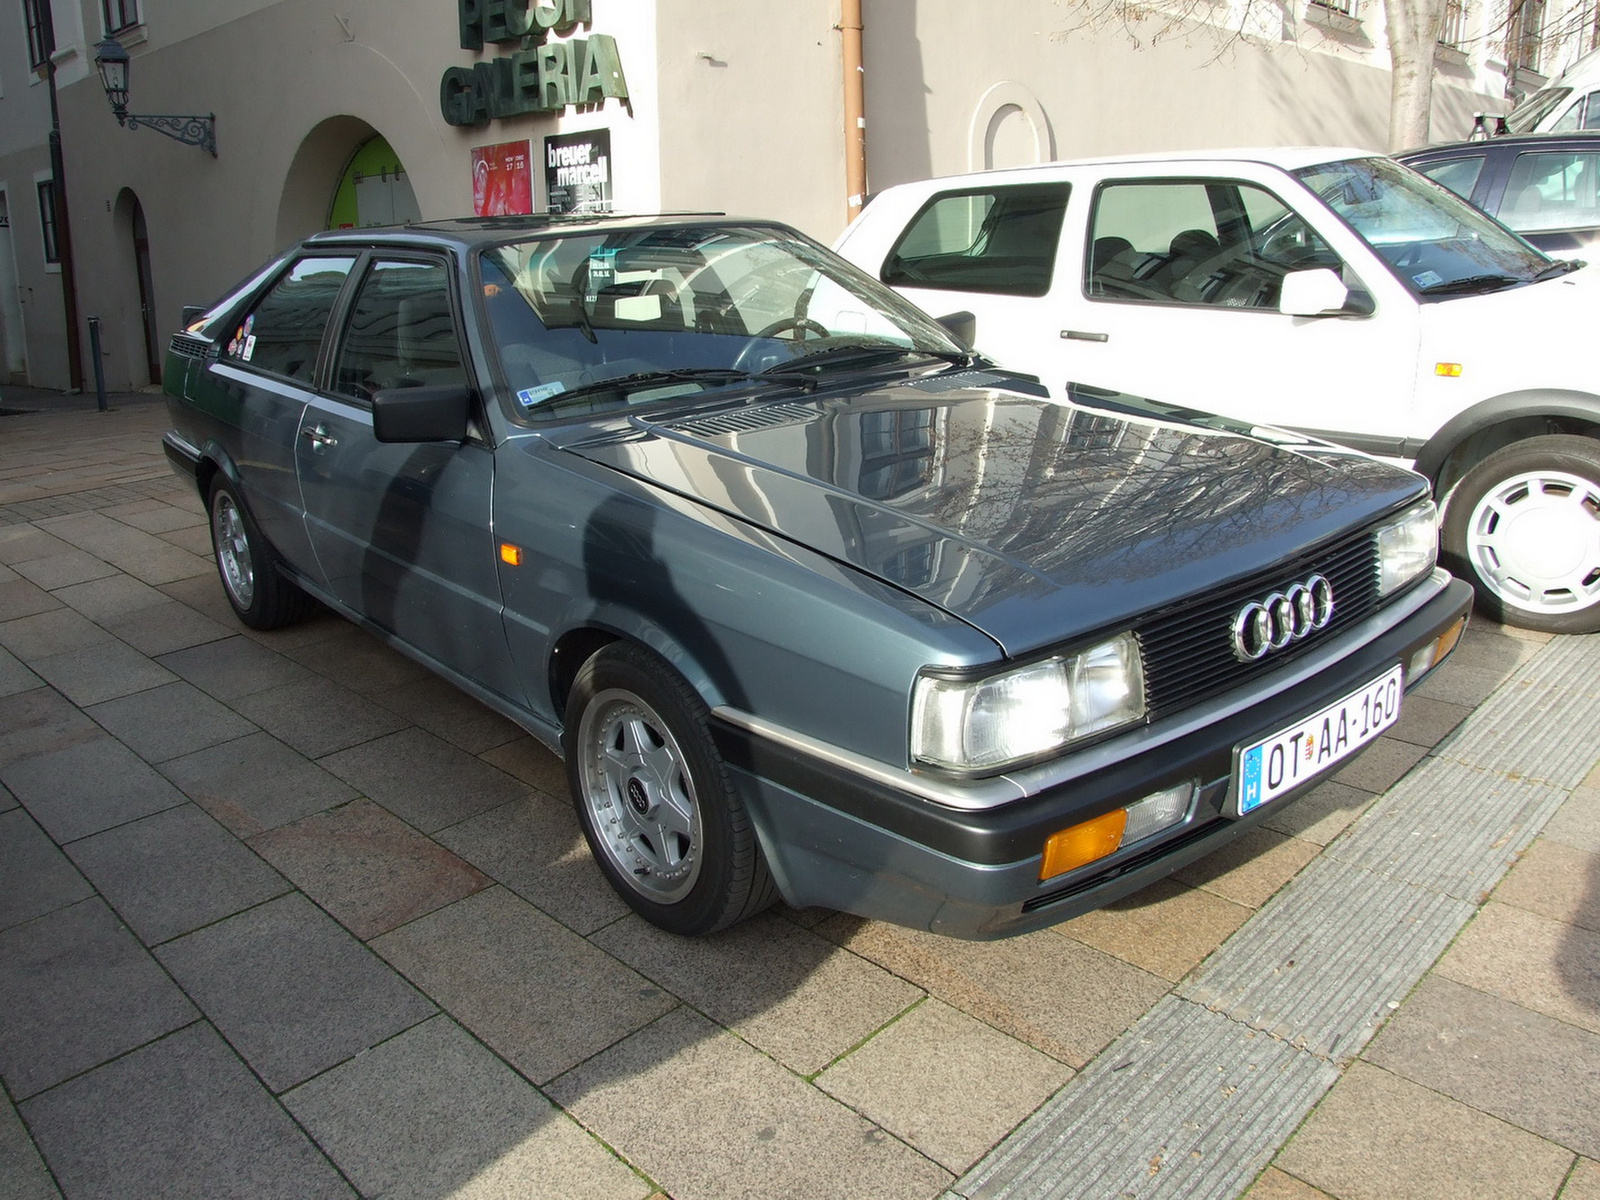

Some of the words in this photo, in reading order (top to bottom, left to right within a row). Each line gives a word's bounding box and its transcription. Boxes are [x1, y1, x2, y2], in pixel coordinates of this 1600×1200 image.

[440, 33, 631, 126] GALÉRIA
[505, 163, 514, 171] 17
[548, 143, 592, 168] breuer
[557, 156, 608, 187] marcell
[1267, 731, 1304, 790] OT
[1317, 678, 1397, 764] AA-160
[1246, 781, 1257, 801] H
